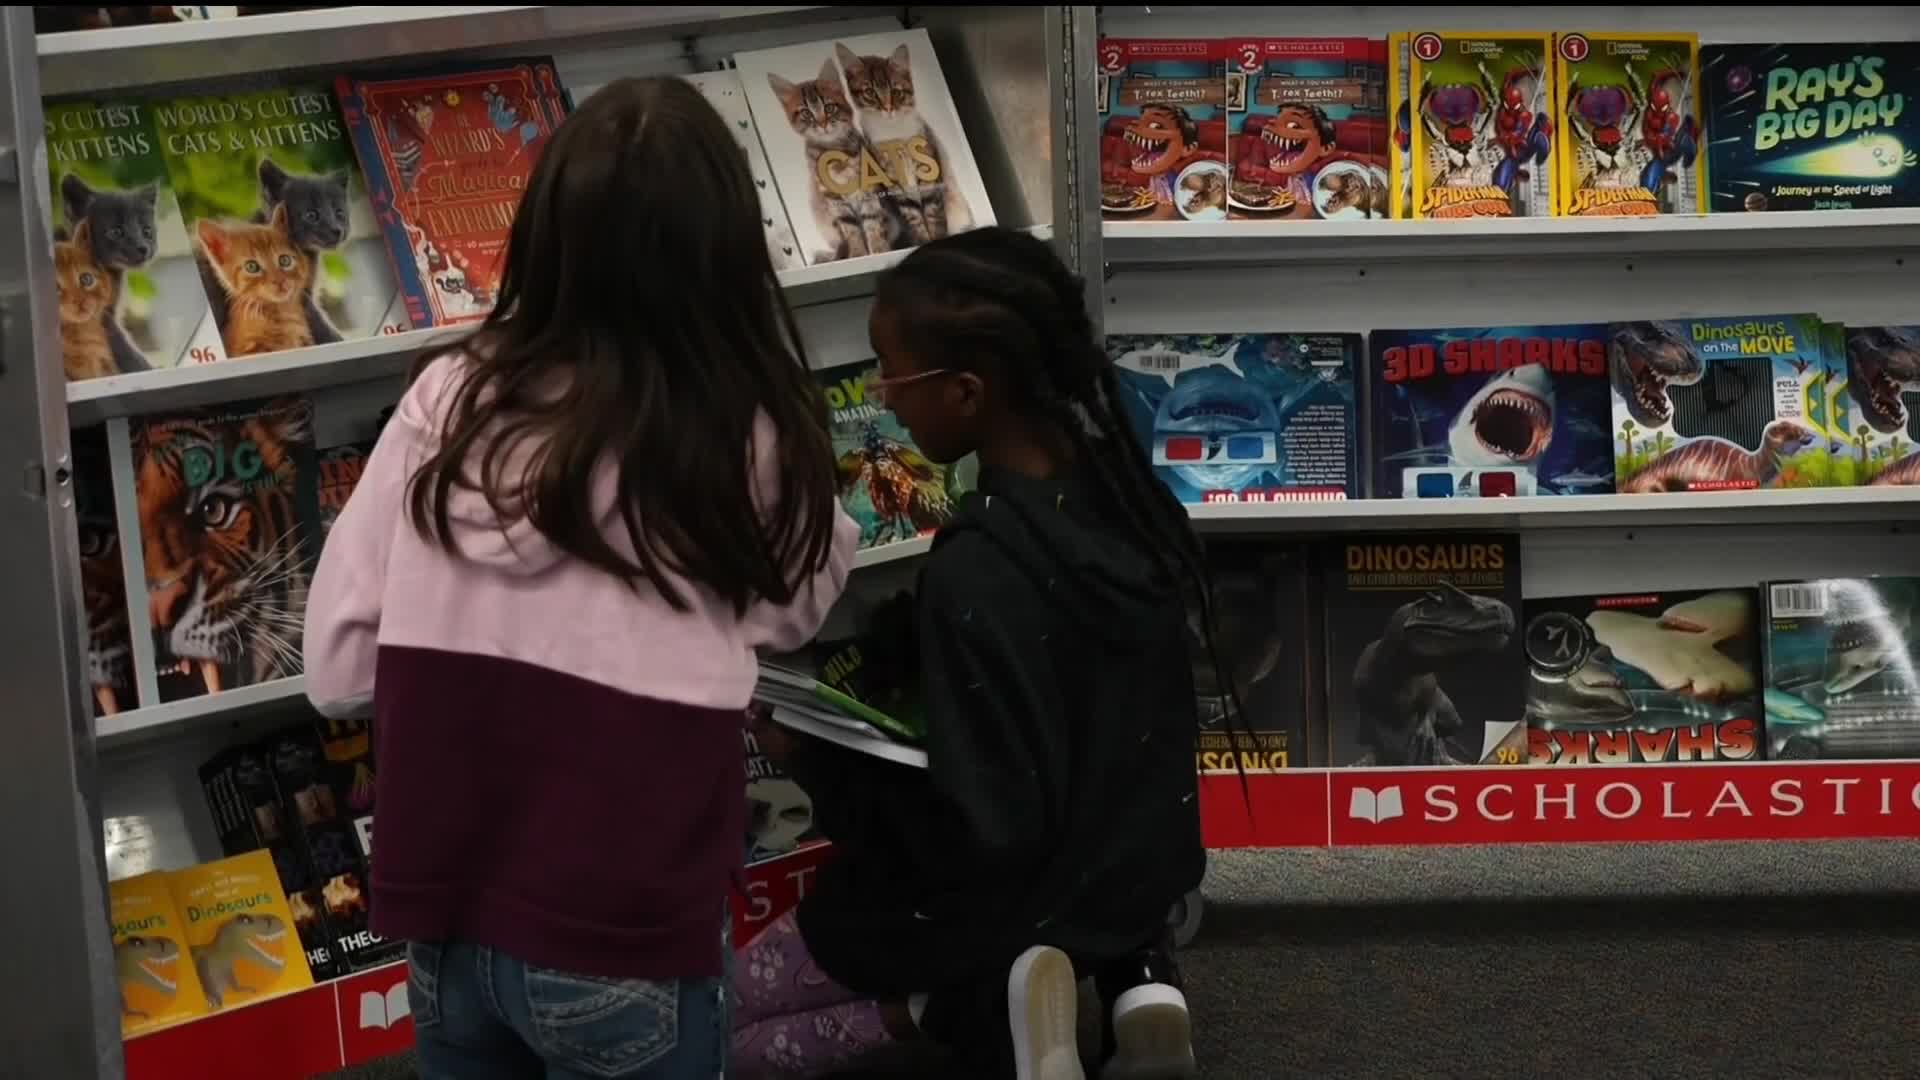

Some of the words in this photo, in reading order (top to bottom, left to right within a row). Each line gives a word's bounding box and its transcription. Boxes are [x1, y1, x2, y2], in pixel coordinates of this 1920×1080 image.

[1106, 52, 1120, 69] 2
[1243, 51, 1257, 68] 2
[1423, 43, 1432, 56] 1
[1570, 44, 1579, 57] 1
[1145, 89, 1163, 98] rex
[1283, 89, 1300, 98] rex
[1765, 55, 1886, 112] RAY'S
[61, 105, 140, 132] CUTEST
[158, 103, 254, 129] WORLD'S
[256, 94, 334, 119] CUTEST
[1754, 107, 1821, 150] BIG
[1825, 93, 1904, 138] DAY
[53, 132, 151, 161] KITTENS
[167, 130, 223, 156] CATS
[228, 133, 246, 151] &
[249, 119, 342, 148] KITTENS
[816, 134, 943, 197] CATS
[1776, 184, 1813, 197] Journey
[1833, 184, 1861, 197] Speed
[1870, 184, 1893, 196] Light
[1691, 321, 1785, 341] Dinosaurs
[1703, 343, 1718, 353] on
[1740, 335, 1796, 355] MOVE
[1383, 343, 1436, 384] 3D
[1442, 336, 1609, 376] SHARKS
[1346, 543, 1504, 572] DINOSAURS
[1496, 747, 1521, 764] 96
[1528, 719, 1757, 765] SHARKS
[1423, 776, 1920, 824] SCHOLASTI
